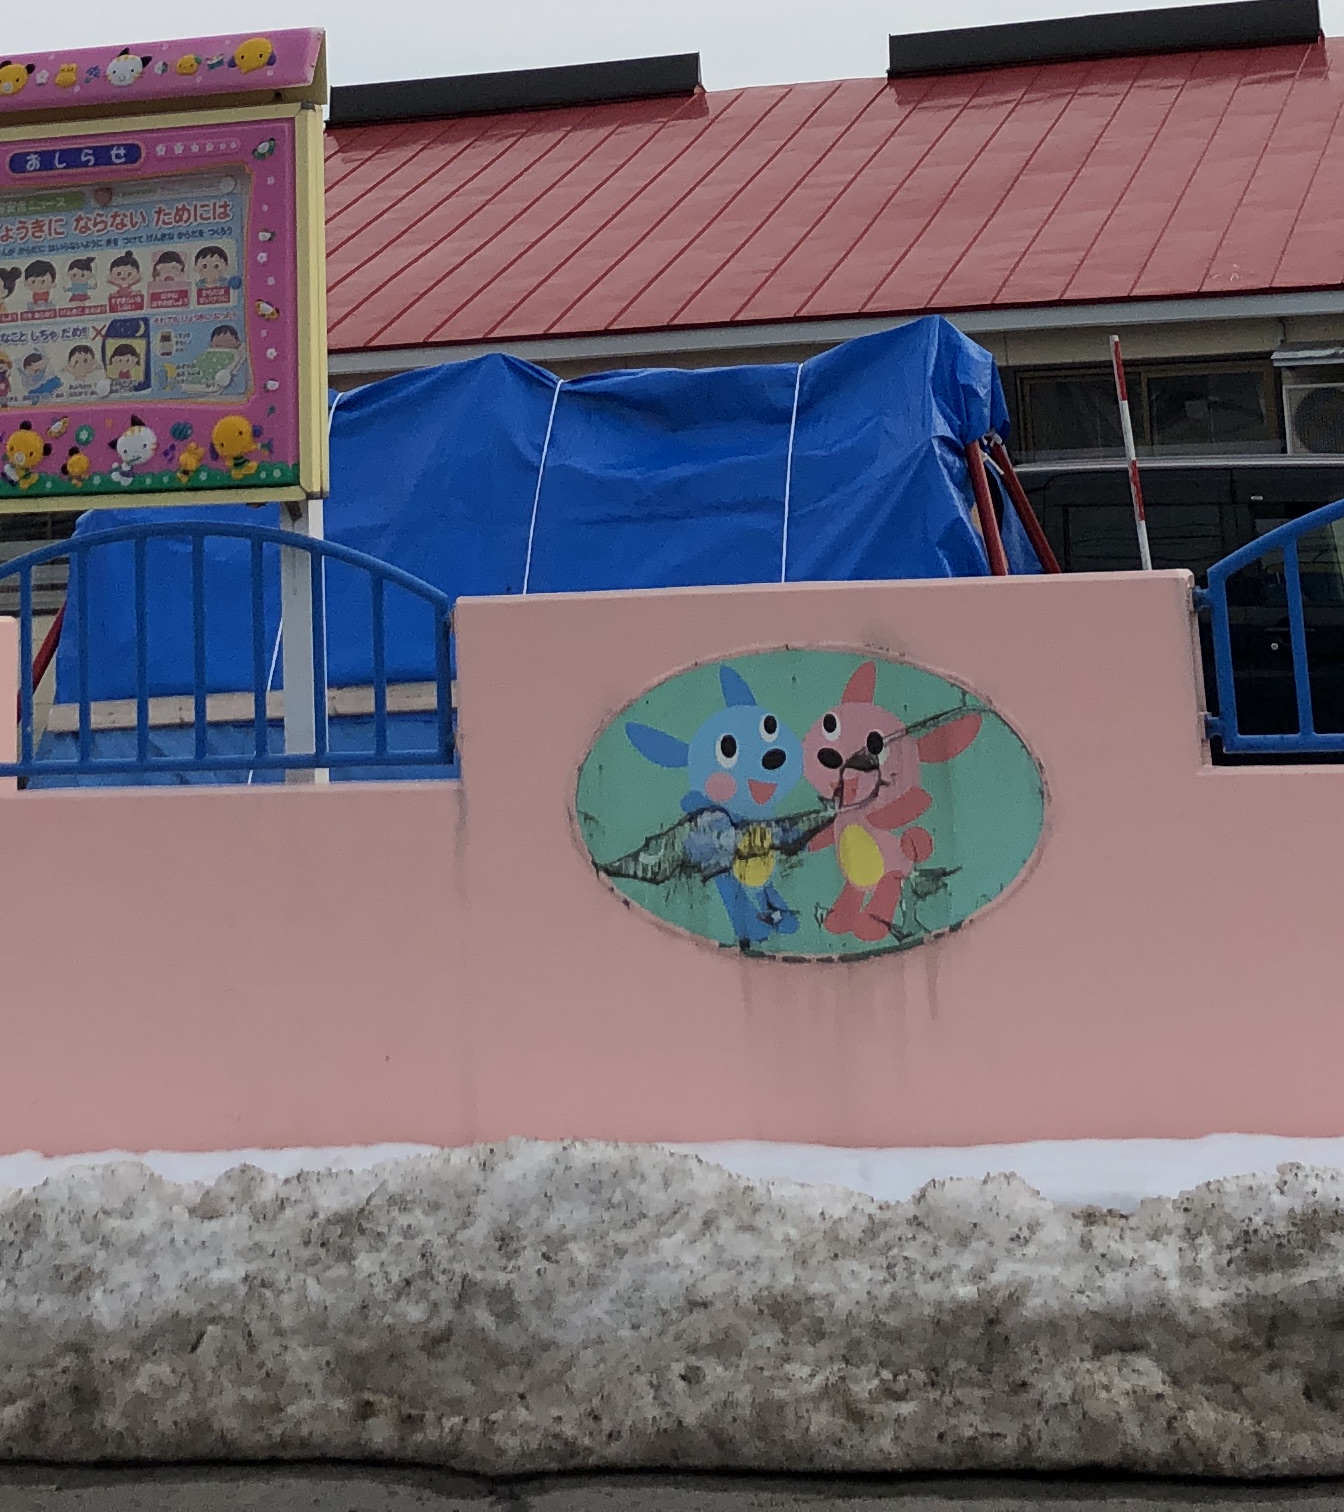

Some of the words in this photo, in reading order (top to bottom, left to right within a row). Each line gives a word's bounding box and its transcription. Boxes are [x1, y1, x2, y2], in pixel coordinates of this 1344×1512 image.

[25, 146, 127, 171] おしらせ
[72, 208, 148, 236] ならない
[153, 199, 233, 228] ためには
[30, 329, 59, 344] しちゃ
